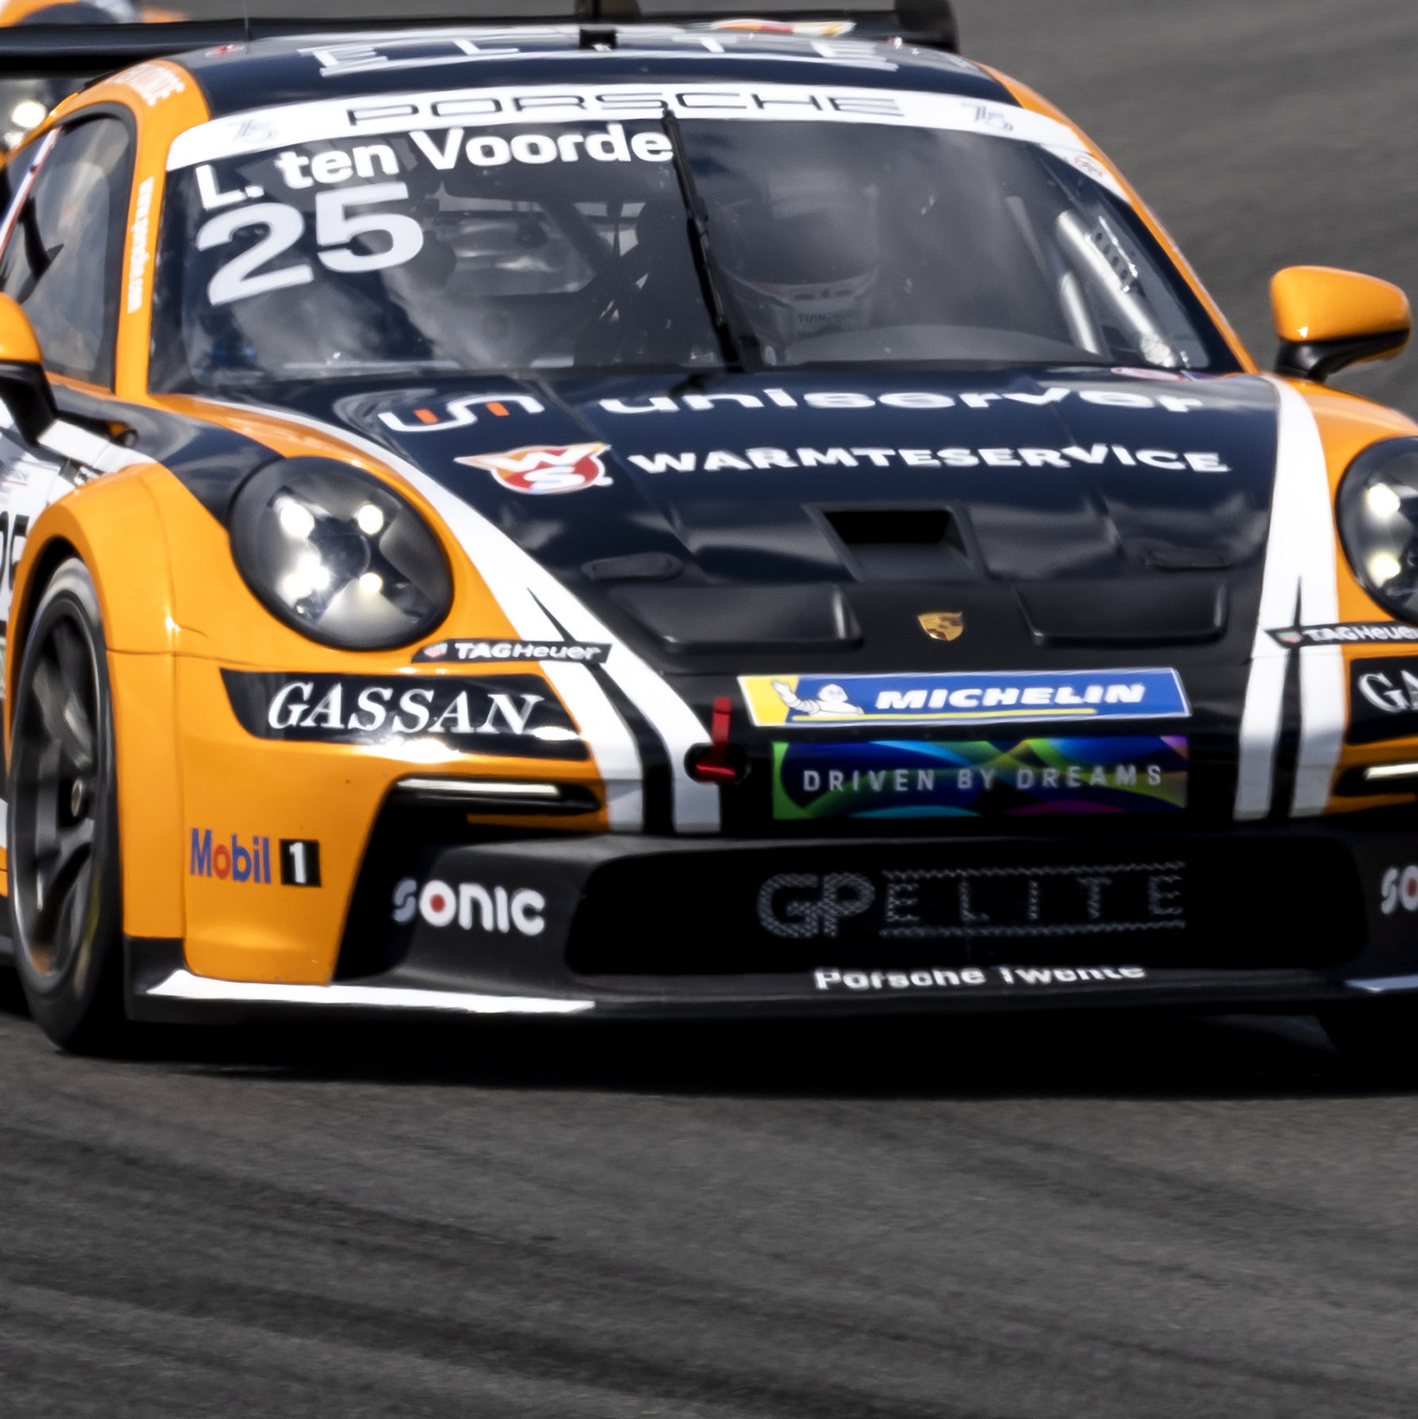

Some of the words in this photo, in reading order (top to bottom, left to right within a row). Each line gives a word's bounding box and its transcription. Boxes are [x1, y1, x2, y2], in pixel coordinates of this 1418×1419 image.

[298, 32, 899, 77] ELIE
[347, 91, 906, 127] PORSCHE
[195, 164, 264, 210] L.
[275, 139, 400, 189] ten
[409, 122, 674, 170] Voorde
[196, 182, 425, 306] 25
[598, 386, 1203, 415] uniserver
[627, 443, 1231, 474] WARMTESERVICE
[267, 681, 544, 734] GASSAN
[875, 683, 1146, 711] MICHELIN
[802, 768, 936, 792] DRIVEN
[957, 767, 995, 790] BY
[1016, 764, 1163, 789] DREAMS
[189, 827, 272, 885] Mobil
[287, 840, 309, 885] 1
[814, 965, 987, 990] Porsche
[999, 964, 1147, 986] Twente
